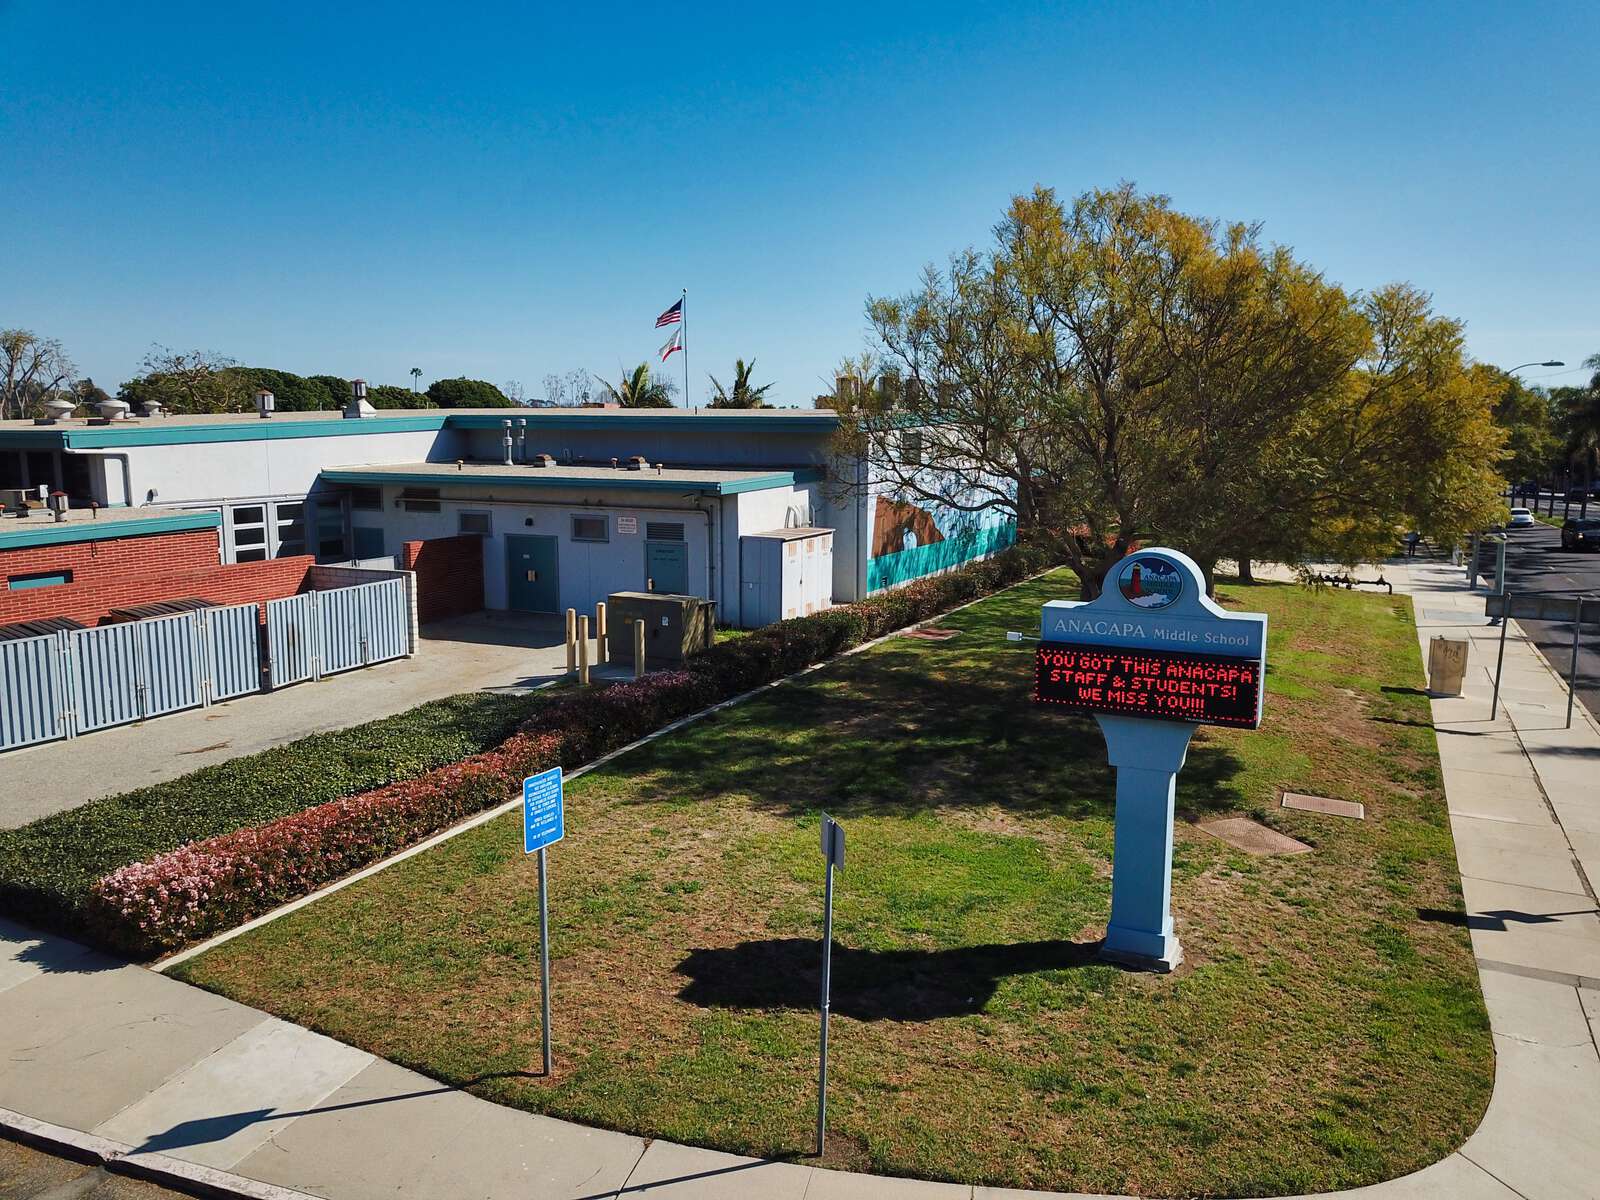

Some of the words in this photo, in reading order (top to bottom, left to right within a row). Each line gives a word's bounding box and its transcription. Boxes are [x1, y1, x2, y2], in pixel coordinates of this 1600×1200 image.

[1054, 619, 1146, 638] ANACAPA
[1153, 628, 1198, 642] Middle
[1204, 632, 1249, 646] School
[1041, 654, 1075, 668] YOU
[1079, 656, 1115, 671] GOT
[1121, 660, 1161, 676] THIS
[1166, 665, 1252, 684] ANACAPA
[1050, 669, 1108, 686] STAFF
[1112, 675, 1126, 688] &
[1131, 677, 1237, 700] STUDENTS!
[1078, 687, 1102, 701] WE
[1107, 691, 1148, 705] MISS
[1154, 694, 1205, 713] YOU!!!
